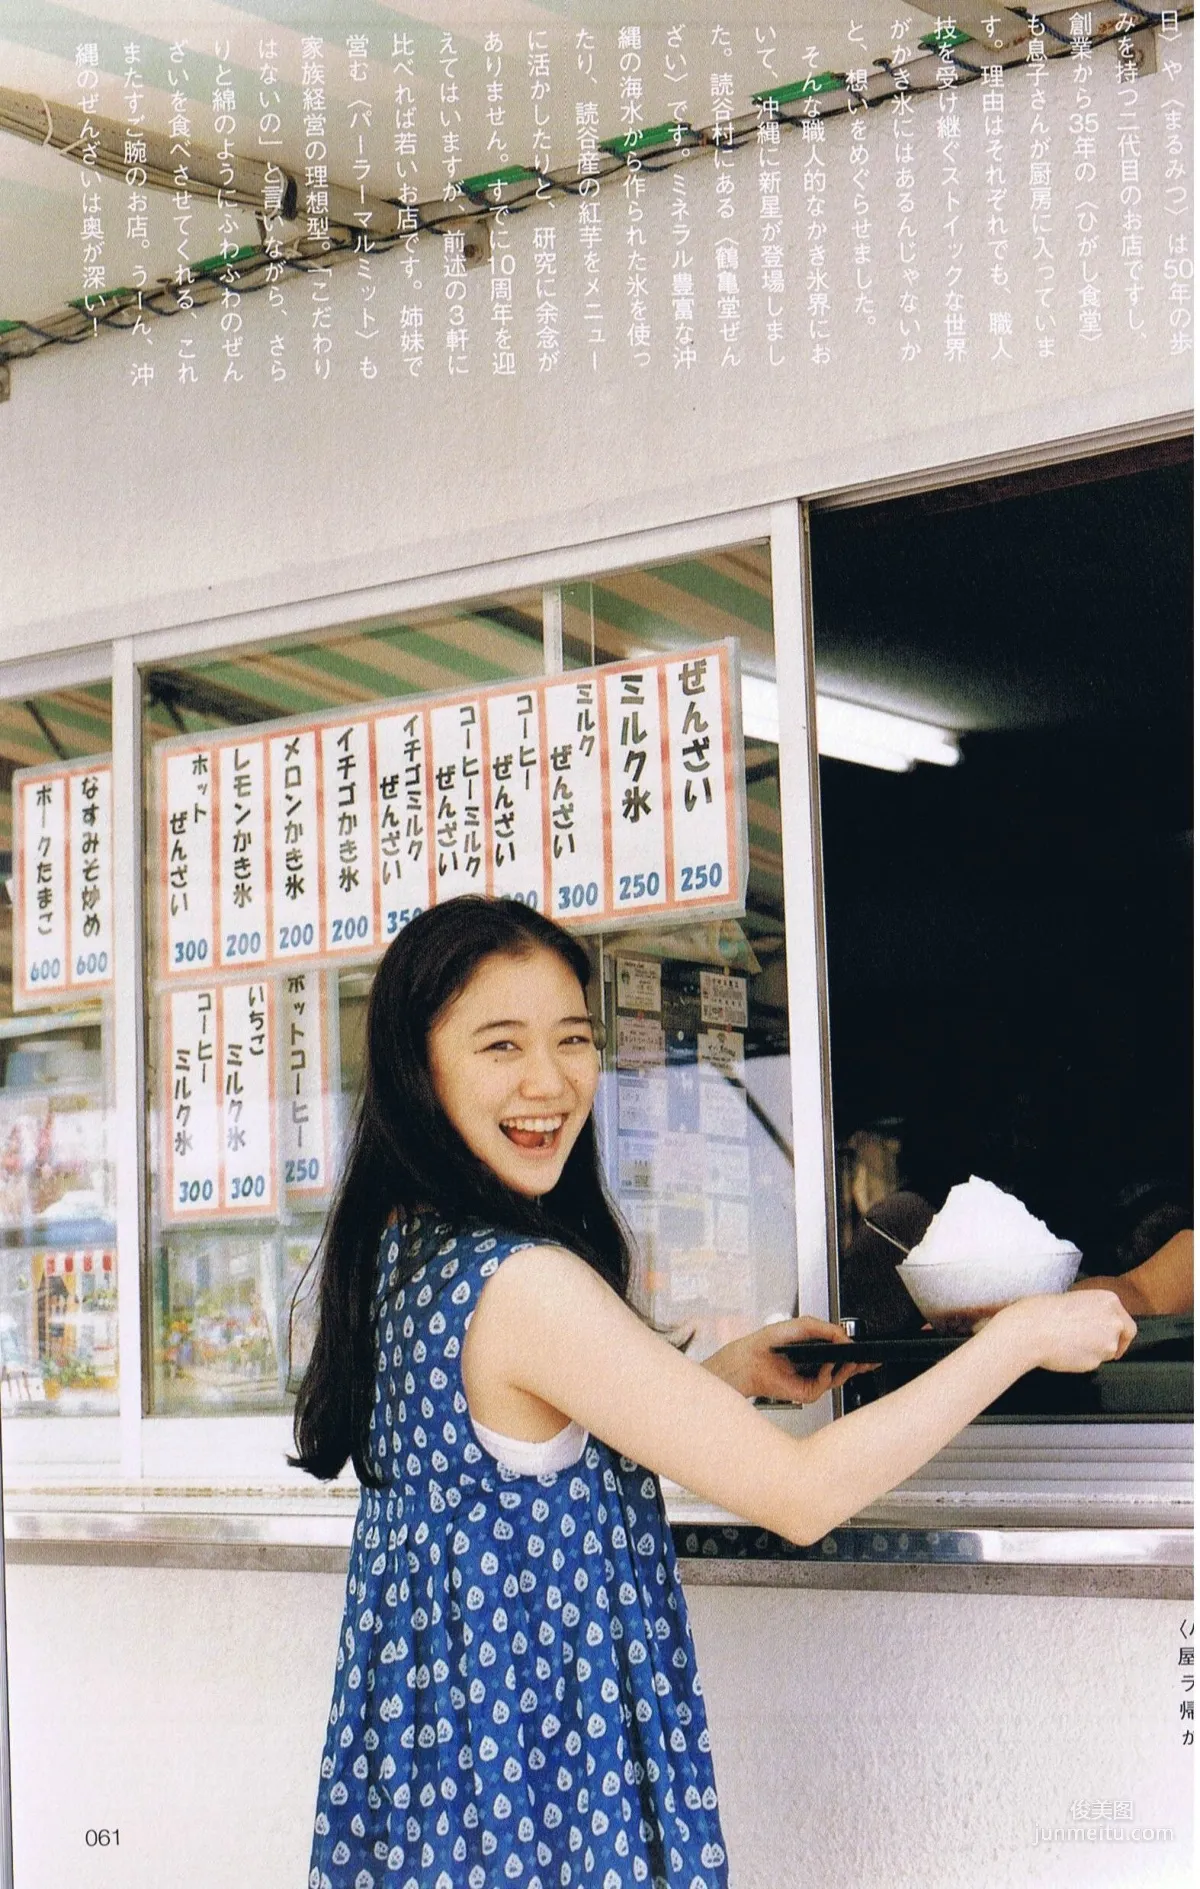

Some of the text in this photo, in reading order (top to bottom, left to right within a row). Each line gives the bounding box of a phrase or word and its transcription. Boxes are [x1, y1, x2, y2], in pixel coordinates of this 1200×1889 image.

[517, 695, 536, 790] コーヒー
[576, 684, 595, 757] ミルク
[621, 674, 651, 823] ミルク氷
[678, 659, 712, 812] ぜんざい
[192, 755, 208, 823] ホット
[233, 749, 252, 908] レモンかき氷
[284, 737, 305, 900] メロンかき氷
[336, 728, 359, 892] イチゴかき氷
[380, 774, 401, 885] ぜんざい
[403, 715, 423, 861] イチゴミルク
[436, 765, 458, 876] ぜんざい
[460, 705, 480, 878] コーヒーミルク
[493, 754, 515, 867] ぜんざい
[550, 744, 575, 858] ぜんざい
[82, 777, 100, 938] なすみそ炒め
[170, 811, 188, 916] ぜんざい
[558, 882, 598, 910] 300
[619, 872, 660, 900] 250
[681, 863, 722, 892] 250
[31, 958, 60, 981] 600
[76, 951, 107, 976] 600
[175, 938, 207, 963] 300
[226, 932, 261, 957] 200
[280, 923, 313, 949] 200
[332, 915, 368, 942] 200
[198, 993, 212, 1083] コーヒー
[288, 975, 309, 1148] ホットコーヒー
[175, 1049, 193, 1156] ミルク氷
[226, 1044, 246, 1152] ミルク氷
[179, 1179, 213, 1203] 300
[231, 1175, 265, 1199] 300
[285, 1158, 320, 1183] 250
